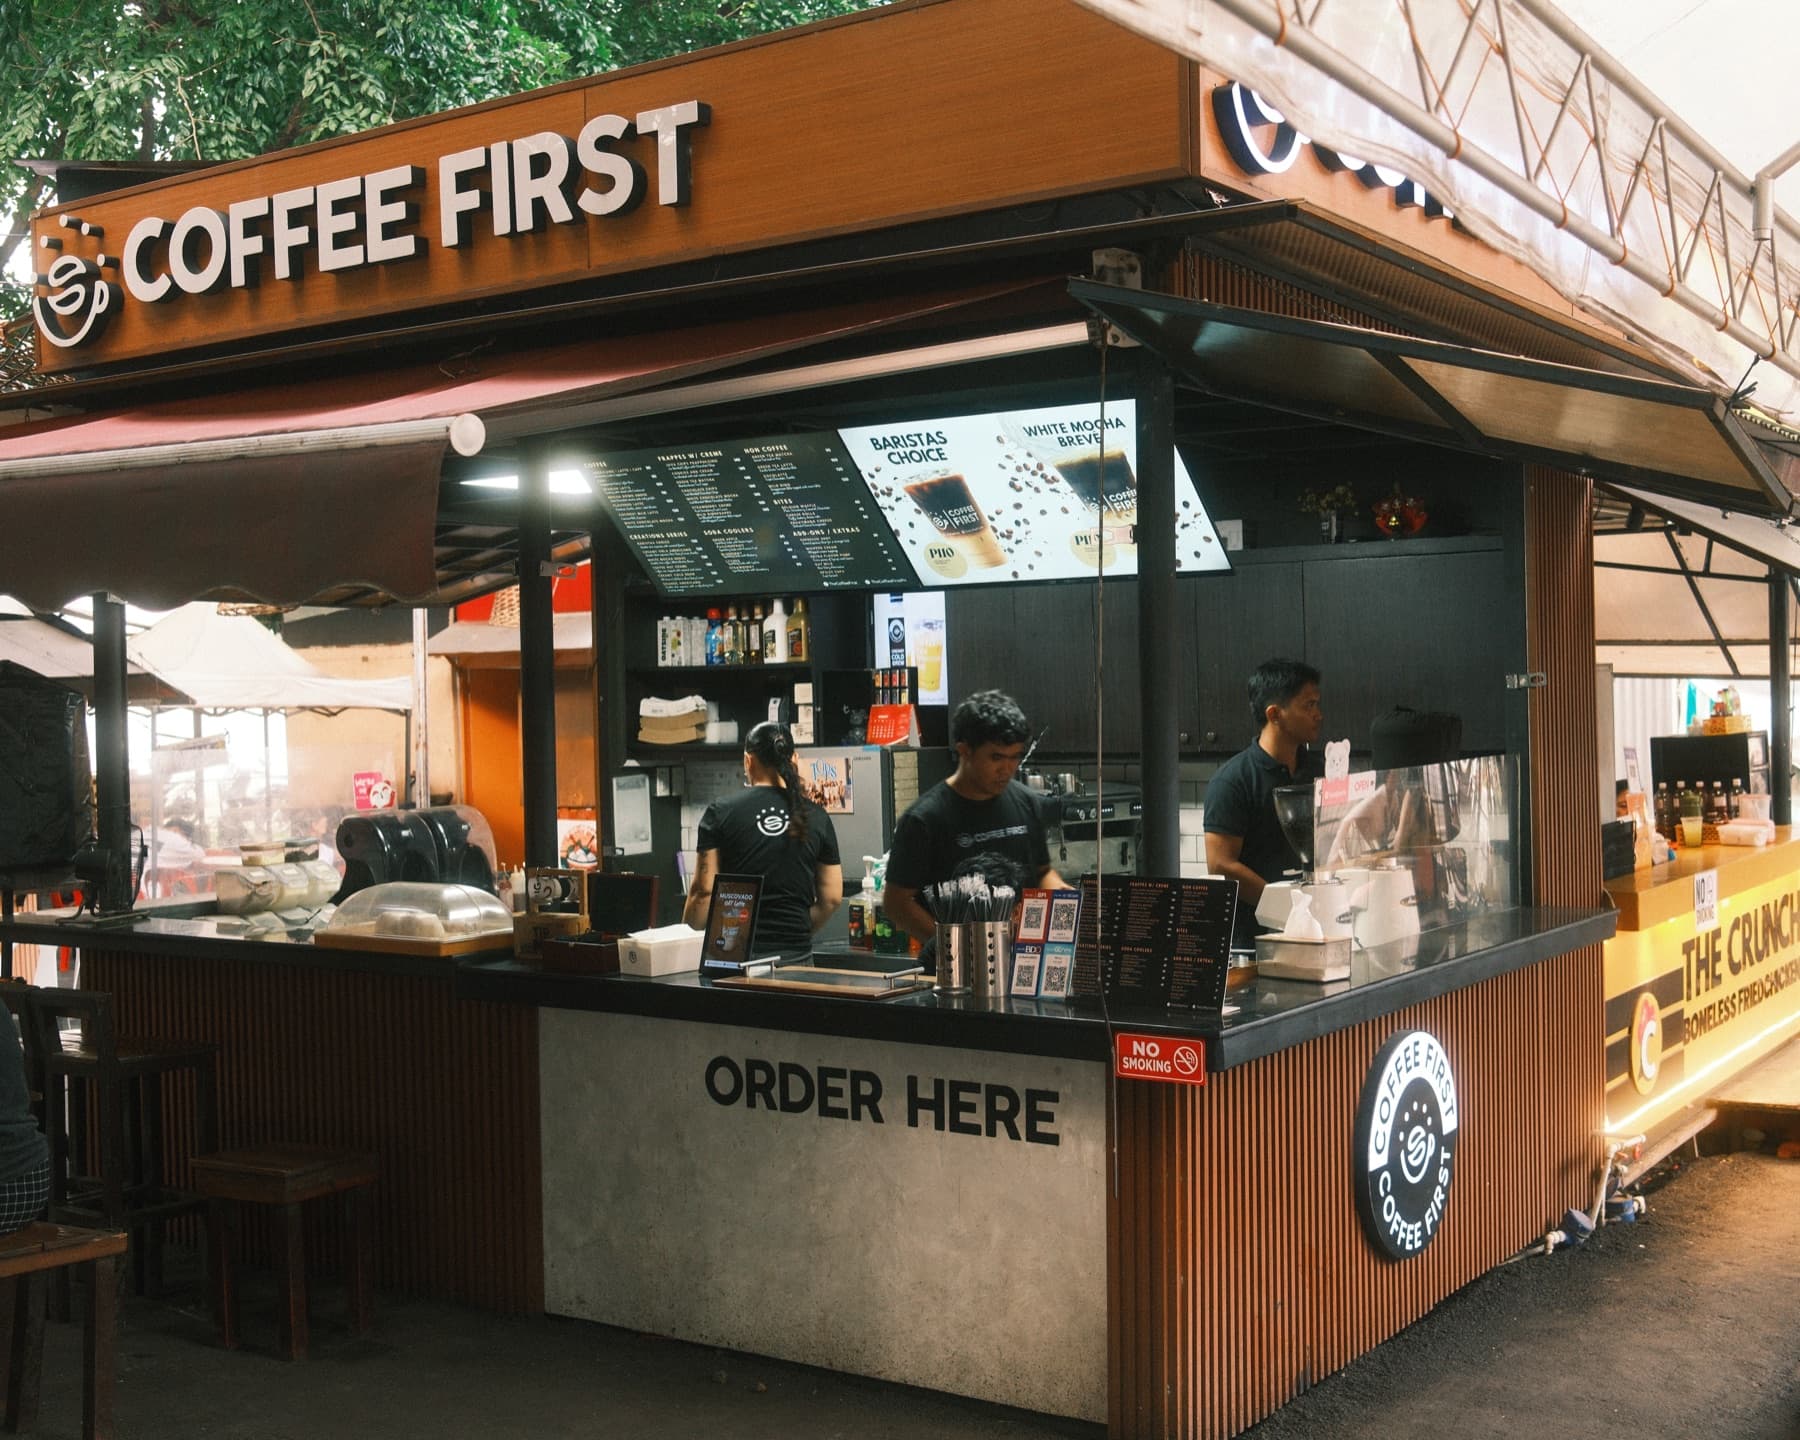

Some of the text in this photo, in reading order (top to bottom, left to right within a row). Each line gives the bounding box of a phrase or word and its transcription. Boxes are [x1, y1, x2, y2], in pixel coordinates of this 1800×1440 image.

[122, 100, 703, 303] COFFEE FIRST
[869, 431, 948, 451] BARISTAS
[1022, 417, 1126, 437] WHITE MOCHA
[887, 447, 948, 466] CHOICE
[953, 512, 980, 526] FIRST
[1696, 877, 1706, 906] NO
[1682, 889, 1800, 1003] THE CRUNCH
[1683, 992, 1737, 1047] BONELESS
[1737, 977, 1764, 1016] FRIED
[1132, 1041, 1160, 1057] NO
[1122, 1056, 1172, 1074] SMOKING
[705, 1055, 1061, 1147] ORDER HERE
[1374, 1040, 1455, 1155] COFFEE FIRST
[1378, 1146, 1451, 1251] COFFEE FIRST
